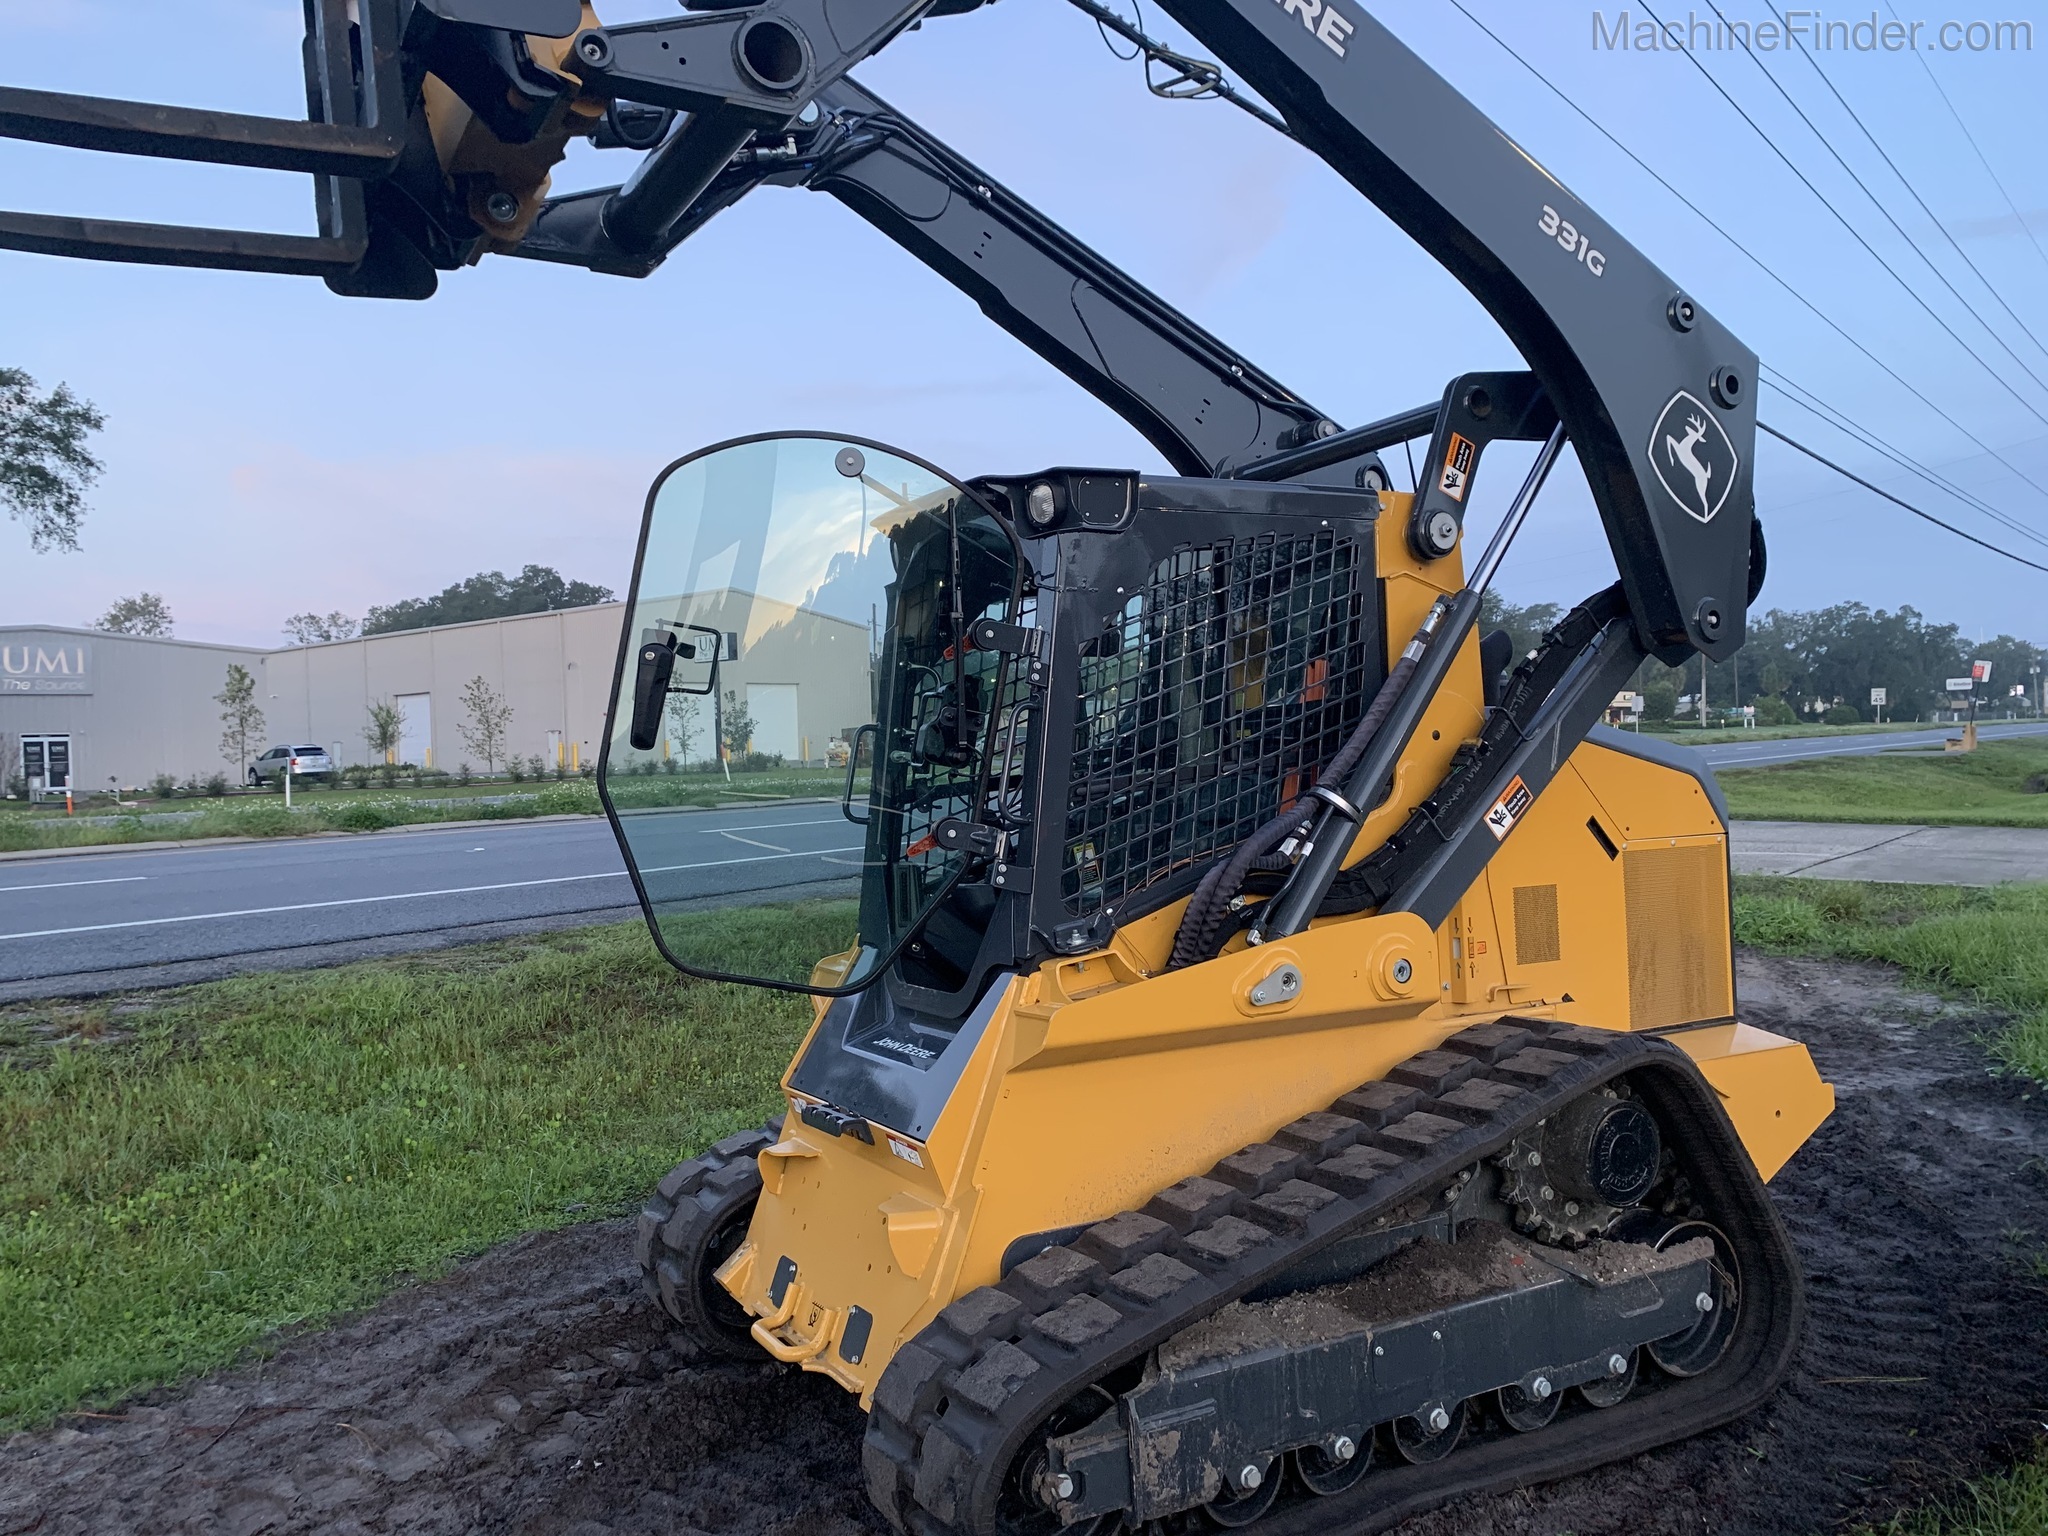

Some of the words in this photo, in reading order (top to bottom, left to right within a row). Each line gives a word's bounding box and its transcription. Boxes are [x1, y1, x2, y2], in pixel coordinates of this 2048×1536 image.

[1538, 204, 1606, 277] 331G
[3, 646, 85, 674] UMI
[3, 679, 31, 690] The
[872, 1037, 904, 1050] JOHN
[896, 1043, 936, 1059] DEERE
